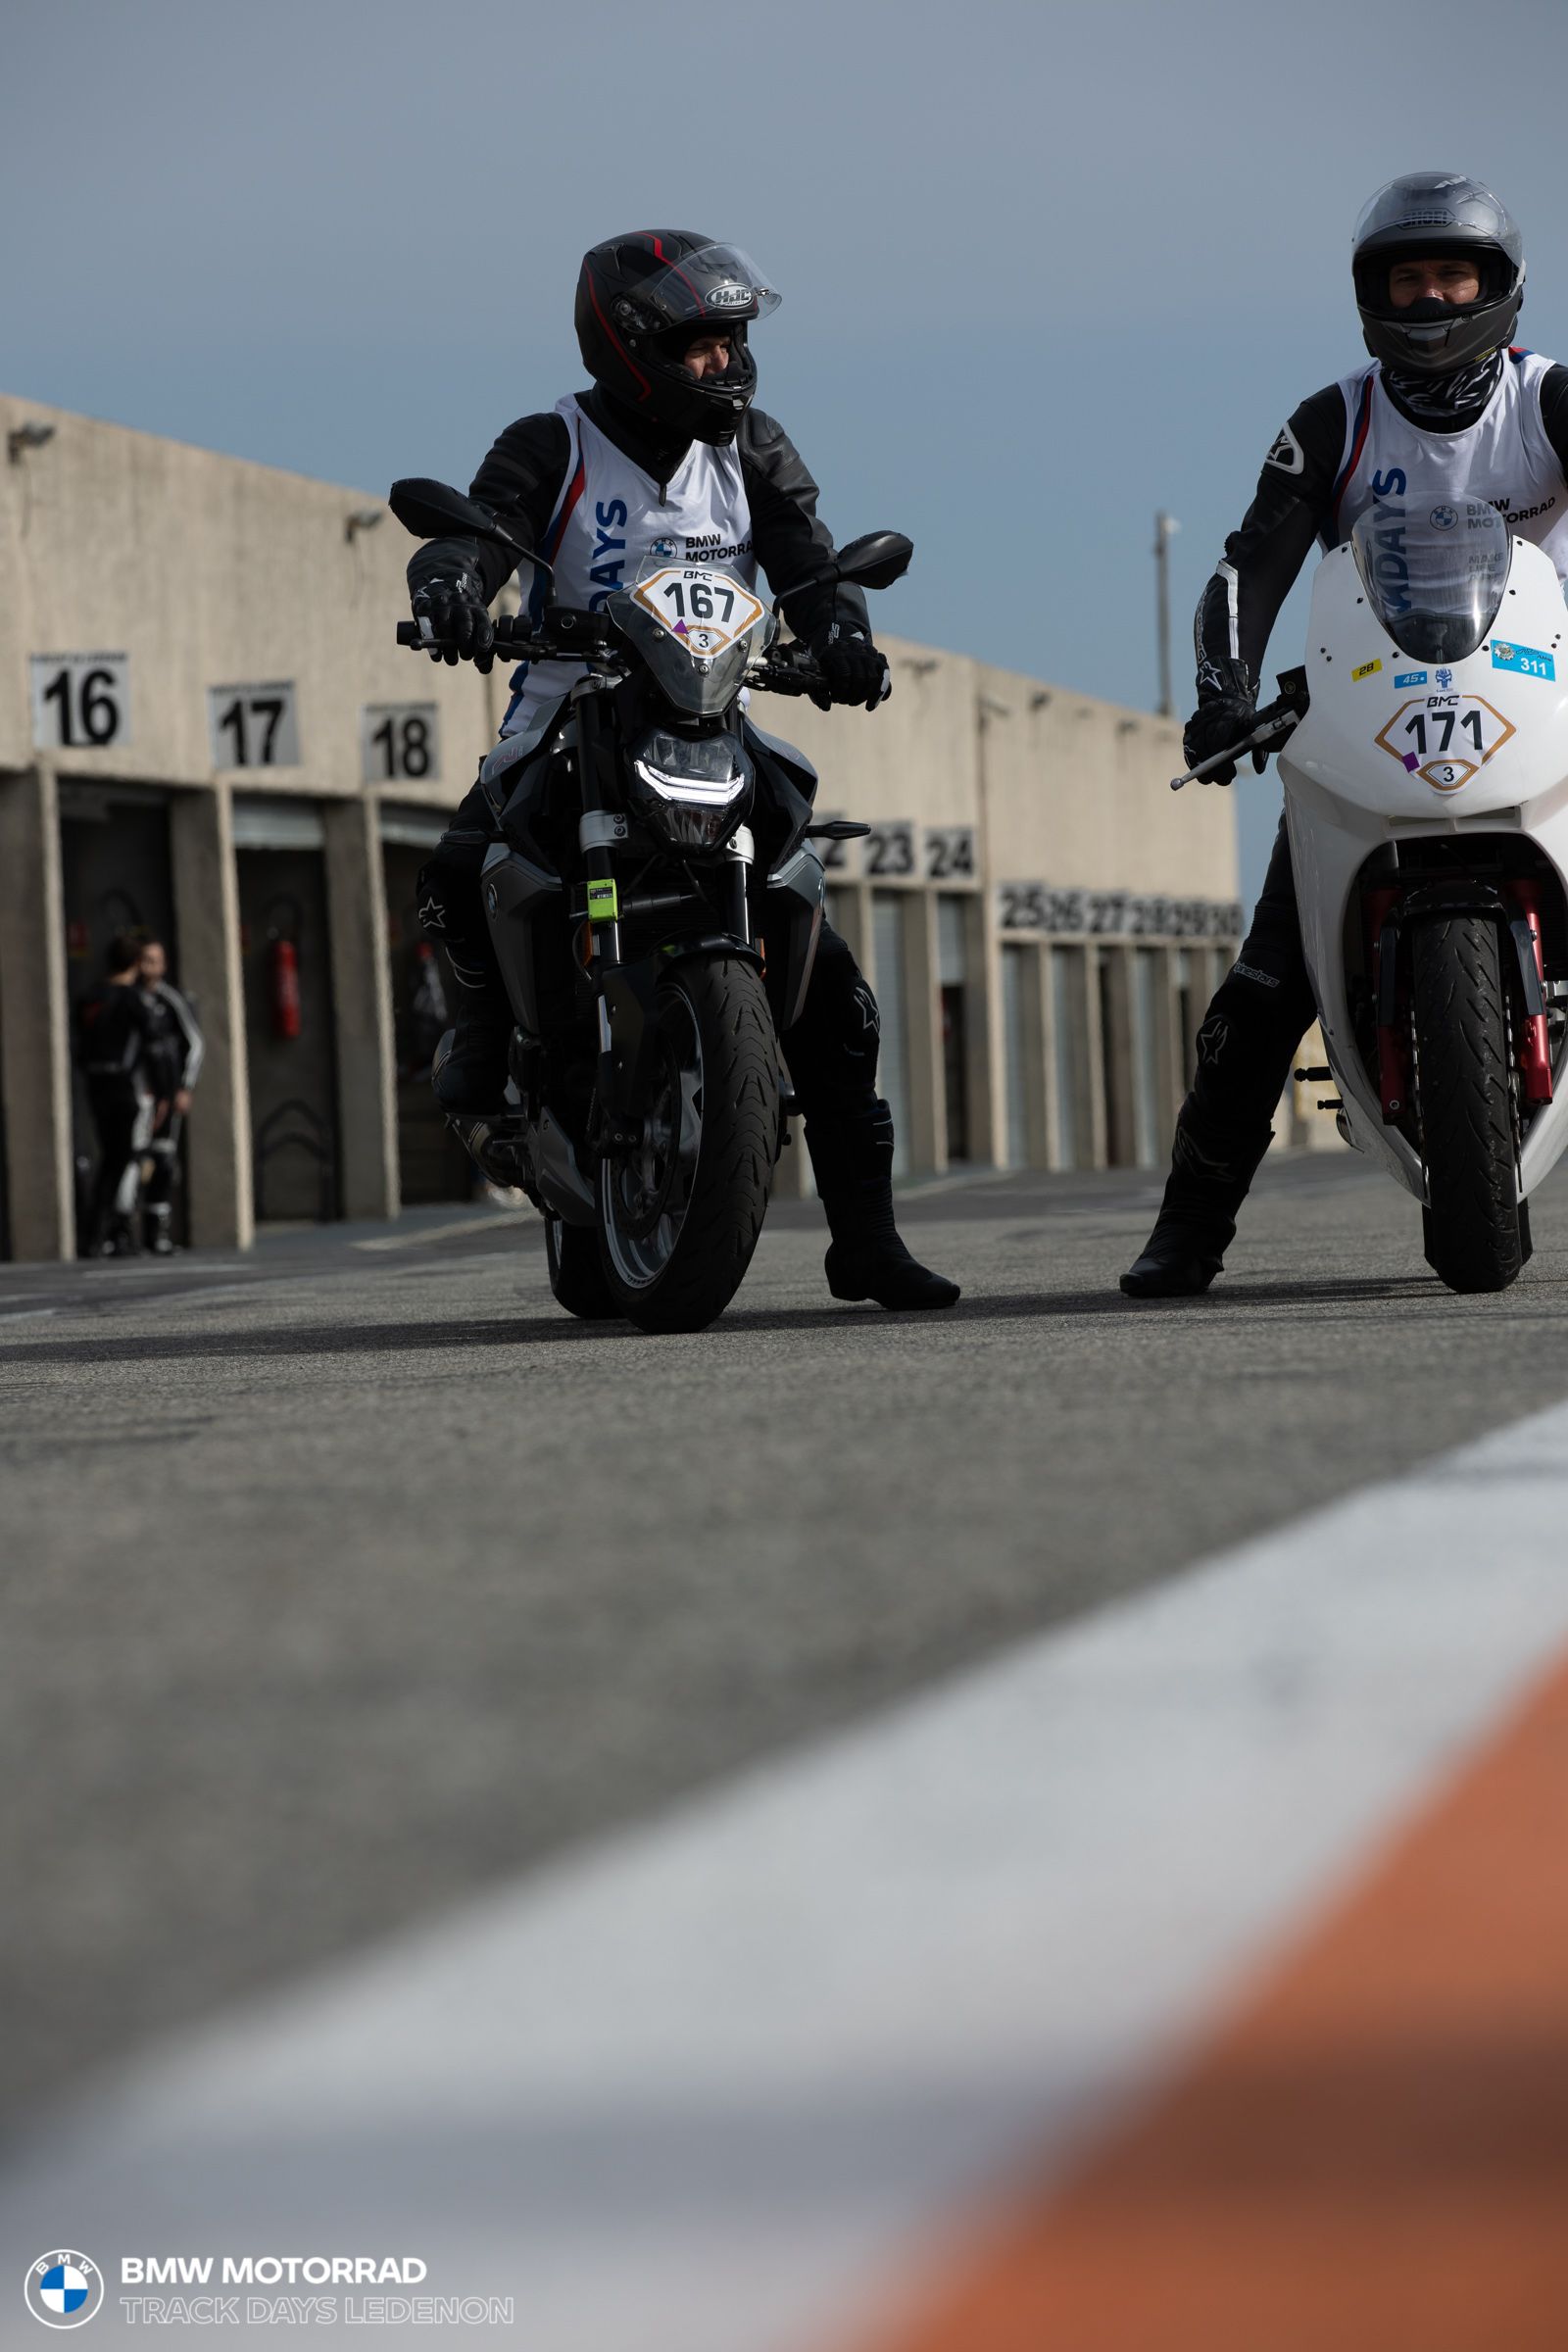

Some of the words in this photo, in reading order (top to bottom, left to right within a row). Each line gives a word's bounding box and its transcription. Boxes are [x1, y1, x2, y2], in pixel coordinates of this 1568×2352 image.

[1402, 211, 1447, 226] SHOEI
[715, 289, 750, 303] HJC
[1467, 498, 1510, 515] BMW
[1467, 496, 1555, 530] MOTORRAD
[686, 533, 720, 548] BMW
[686, 540, 753, 563] MOTORRA
[1372, 467, 1412, 615] KDAYS
[683, 570, 712, 581] BMC
[663, 582, 735, 622] 167
[698, 633, 710, 648] 3
[1359, 662, 1374, 676] 28
[1520, 658, 1546, 676] 311
[44, 668, 120, 746] 16
[1427, 695, 1460, 708] BMC
[219, 697, 285, 767] 17
[1404, 710, 1483, 755] 171
[372, 716, 431, 780] 18
[1443, 766, 1454, 782] 3
[866, 833, 913, 874] 23
[927, 837, 972, 876] 24
[1001, 885, 1045, 929] 25
